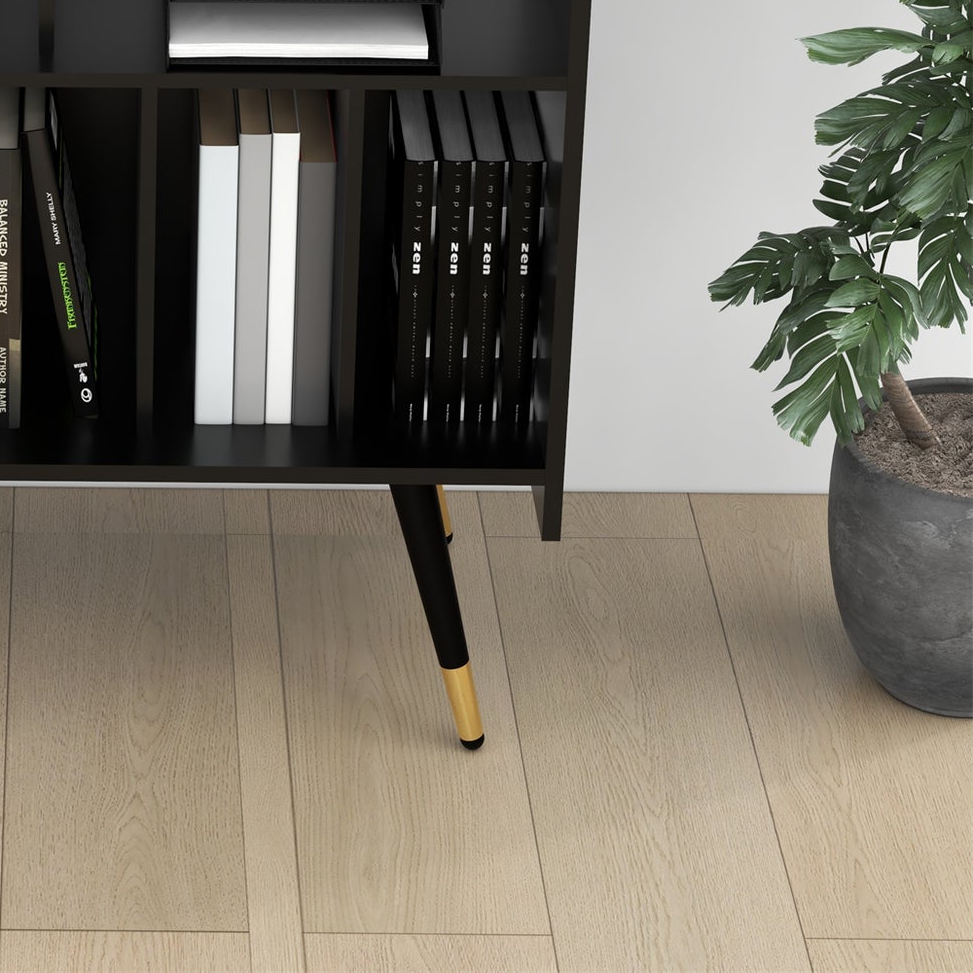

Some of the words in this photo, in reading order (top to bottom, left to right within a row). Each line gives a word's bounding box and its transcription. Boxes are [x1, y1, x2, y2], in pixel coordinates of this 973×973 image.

[46, 192, 57, 221] SHELLY
[0, 199, 8, 257] BALANCED
[51, 222, 61, 245] MARY
[412, 242, 422, 275] zen
[449, 242, 460, 275] zen
[482, 242, 492, 275] zen
[520, 243, 530, 276] zen
[0, 346, 7, 384] AUTHOR
[0, 387, 7, 413] NAME
